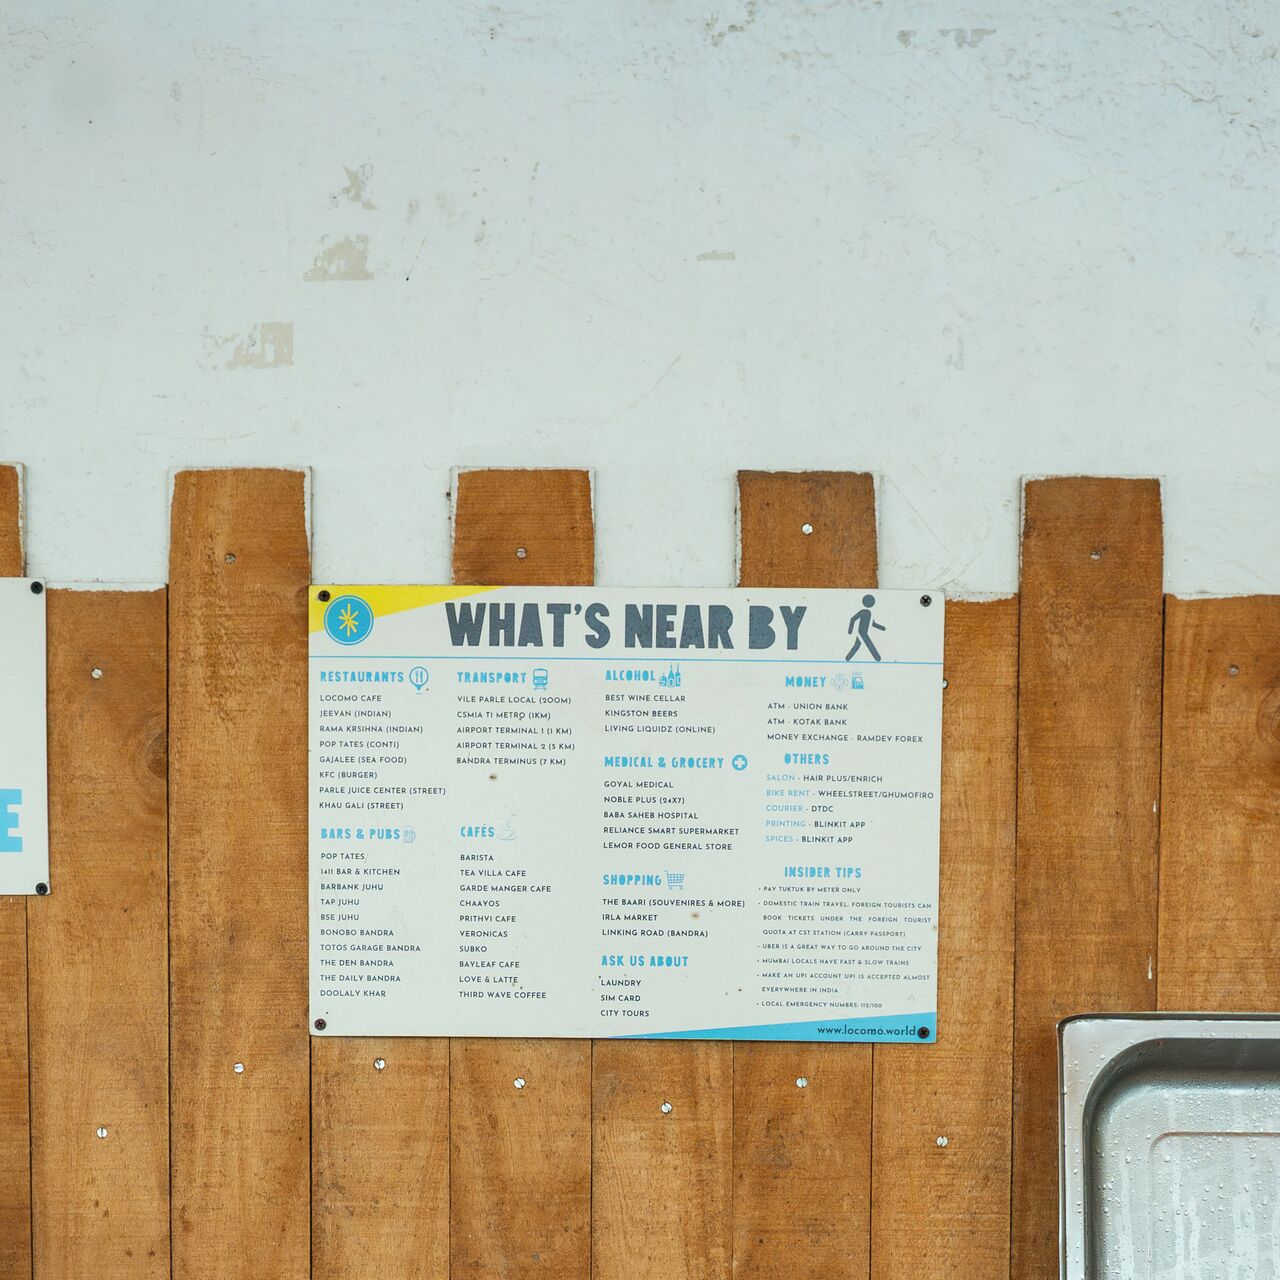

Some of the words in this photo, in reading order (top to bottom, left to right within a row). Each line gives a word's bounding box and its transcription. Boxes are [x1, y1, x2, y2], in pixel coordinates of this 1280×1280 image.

[445, 602, 611, 649] WHAT'S
[624, 604, 734, 649] NEAR
[748, 605, 807, 650] BY
[320, 671, 404, 683] RESTAURANTS
[457, 672, 527, 684] TRANSPORT
[605, 670, 655, 681] ALCOHOL
[785, 676, 826, 687] MONEY
[320, 694, 358, 702] LOCOMO
[767, 702, 785, 710] ATM
[825, 703, 848, 711] BANK
[319, 710, 351, 718] JEEVAN
[354, 710, 391, 718] (INDIAN)
[605, 709, 649, 717] KINGSTON
[559, 743, 575, 751] KM)
[319, 756, 355, 764] GAJALEE
[358, 756, 377, 764] (SEA
[379, 756, 407, 764] FOOD)
[494, 757, 537, 765] TERMINUS
[550, 758, 566, 766] KM)
[604, 756, 653, 768] MEDICAL
[658, 756, 666, 768] &
[671, 757, 724, 768] GROCERY
[784, 753, 829, 765] OTHERS
[338, 771, 377, 779] (BURGER)
[604, 780, 633, 788] GOYAL
[319, 786, 345, 794] PARLE
[347, 787, 371, 795] JUICE
[409, 787, 446, 796] (STREET)
[766, 804, 803, 812] COURIER
[811, 805, 834, 813] DTDC
[628, 811, 655, 819] SAHEB
[321, 828, 351, 839] BARS
[356, 828, 364, 840] &
[369, 828, 400, 840] PUBS
[603, 826, 645, 834] RELIANCE
[679, 827, 739, 835] SUPERMARKET
[636, 842, 660, 850] FOOD
[663, 842, 703, 850] GENERAL
[705, 843, 732, 851] STORE
[478, 869, 503, 877] VILLA
[784, 866, 830, 878] INSIDER
[836, 867, 861, 879] TIPS
[603, 874, 662, 886] SHOPPING
[460, 884, 488, 892] GARDE
[459, 899, 500, 907] CHAAYOS
[495, 915, 516, 923] CAFE
[459, 930, 508, 938] VERONICAS
[667, 930, 708, 938] (BANDRA)
[386, 944, 421, 952] BANDRA
[459, 945, 487, 953] SUBKO
[601, 955, 624, 966] ASK
[630, 955, 645, 966] US
[649, 955, 688, 967] ABOUT
[339, 974, 364, 982] DAILY
[601, 979, 641, 987] LAUNDRY
[320, 989, 360, 997] DOOLALY
[817, 1024, 916, 1036] www.locomo.world
